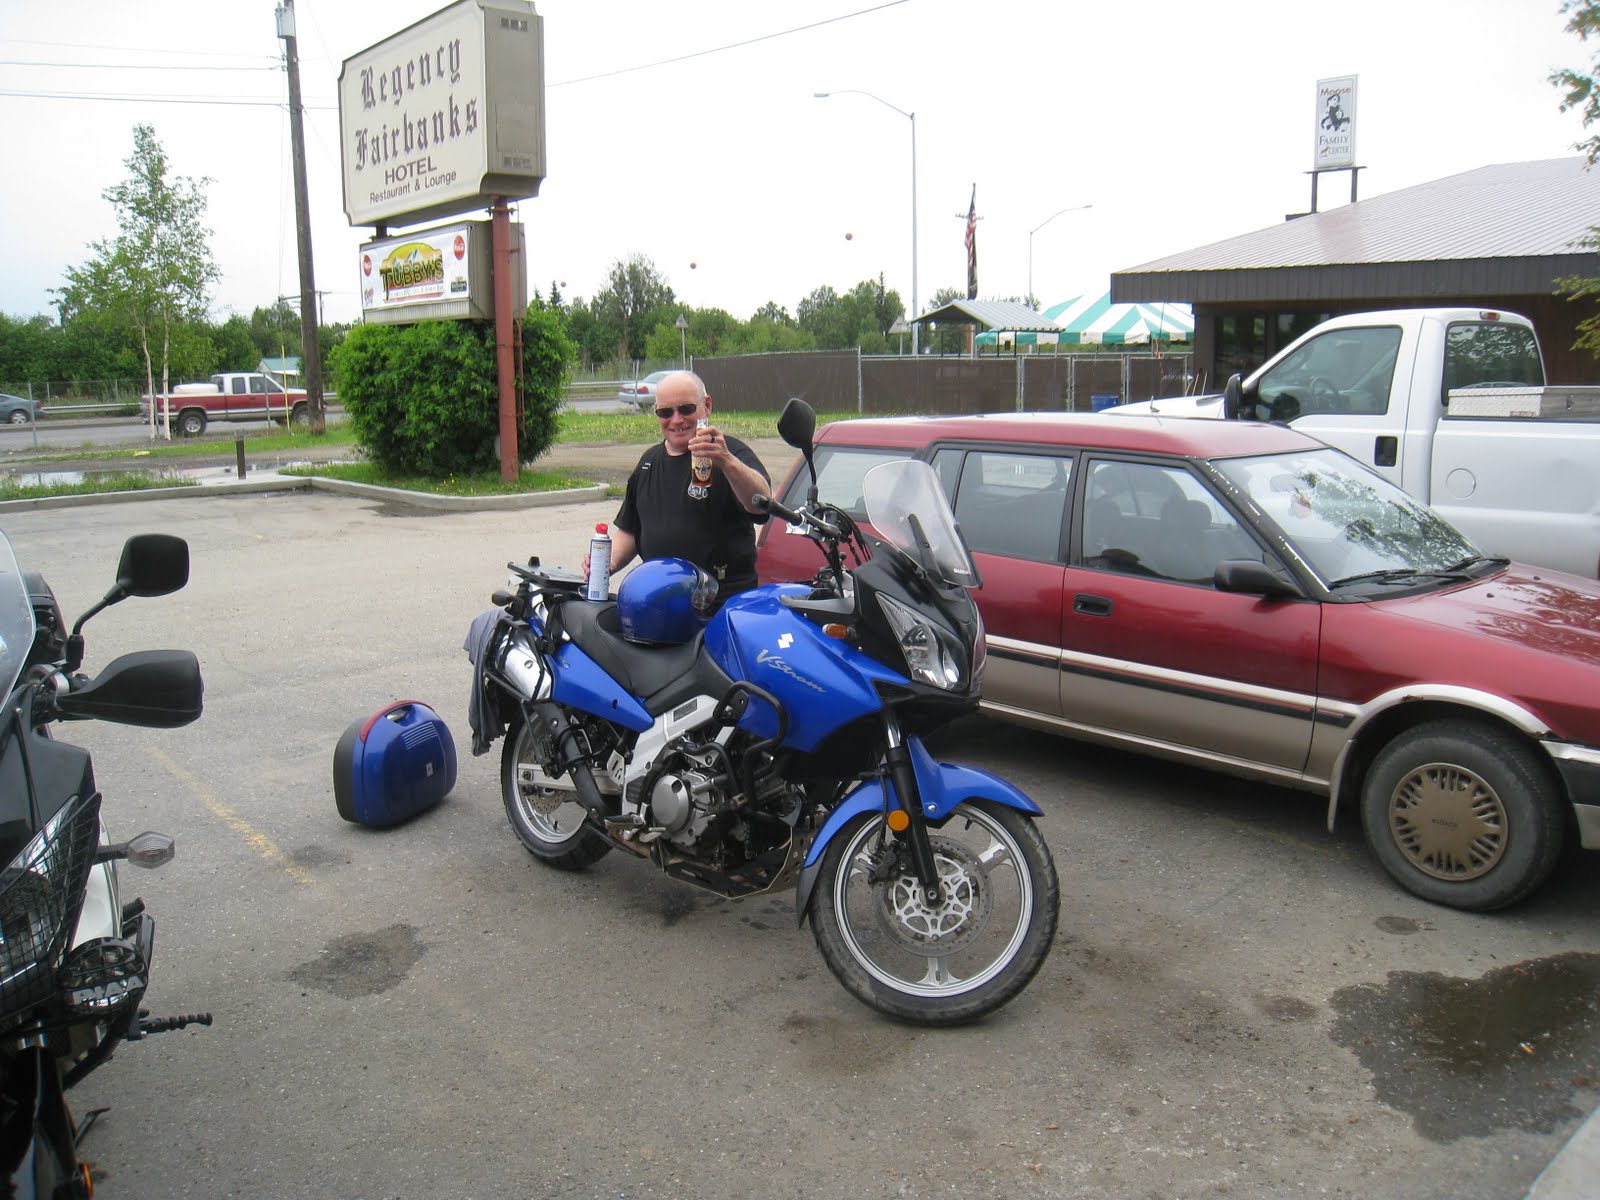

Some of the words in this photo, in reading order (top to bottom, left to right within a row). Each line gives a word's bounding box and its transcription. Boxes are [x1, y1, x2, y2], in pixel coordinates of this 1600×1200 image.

[360, 38, 461, 111] Regency
[1320, 87, 1352, 97] Moose
[355, 93, 479, 171] Fairbanks
[369, 182, 411, 205] Restaurant
[414, 179, 421, 191] &
[424, 170, 457, 189] Lounge
[384, 156, 438, 186] HOTEL
